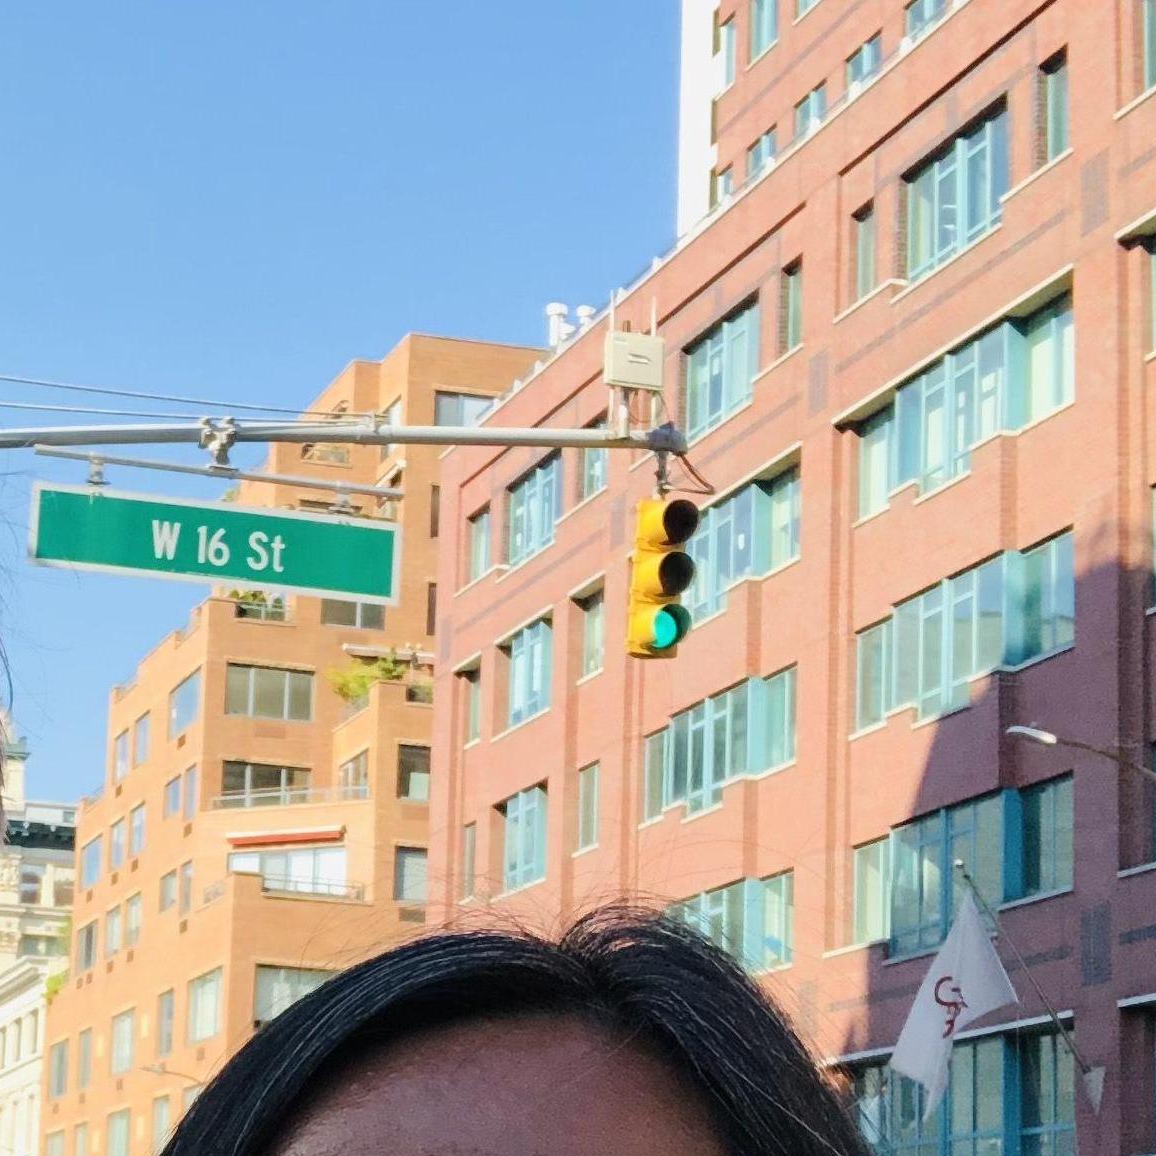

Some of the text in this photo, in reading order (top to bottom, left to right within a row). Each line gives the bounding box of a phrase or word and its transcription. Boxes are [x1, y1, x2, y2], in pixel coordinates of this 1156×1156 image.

[151, 519, 287, 573] W 16 St
